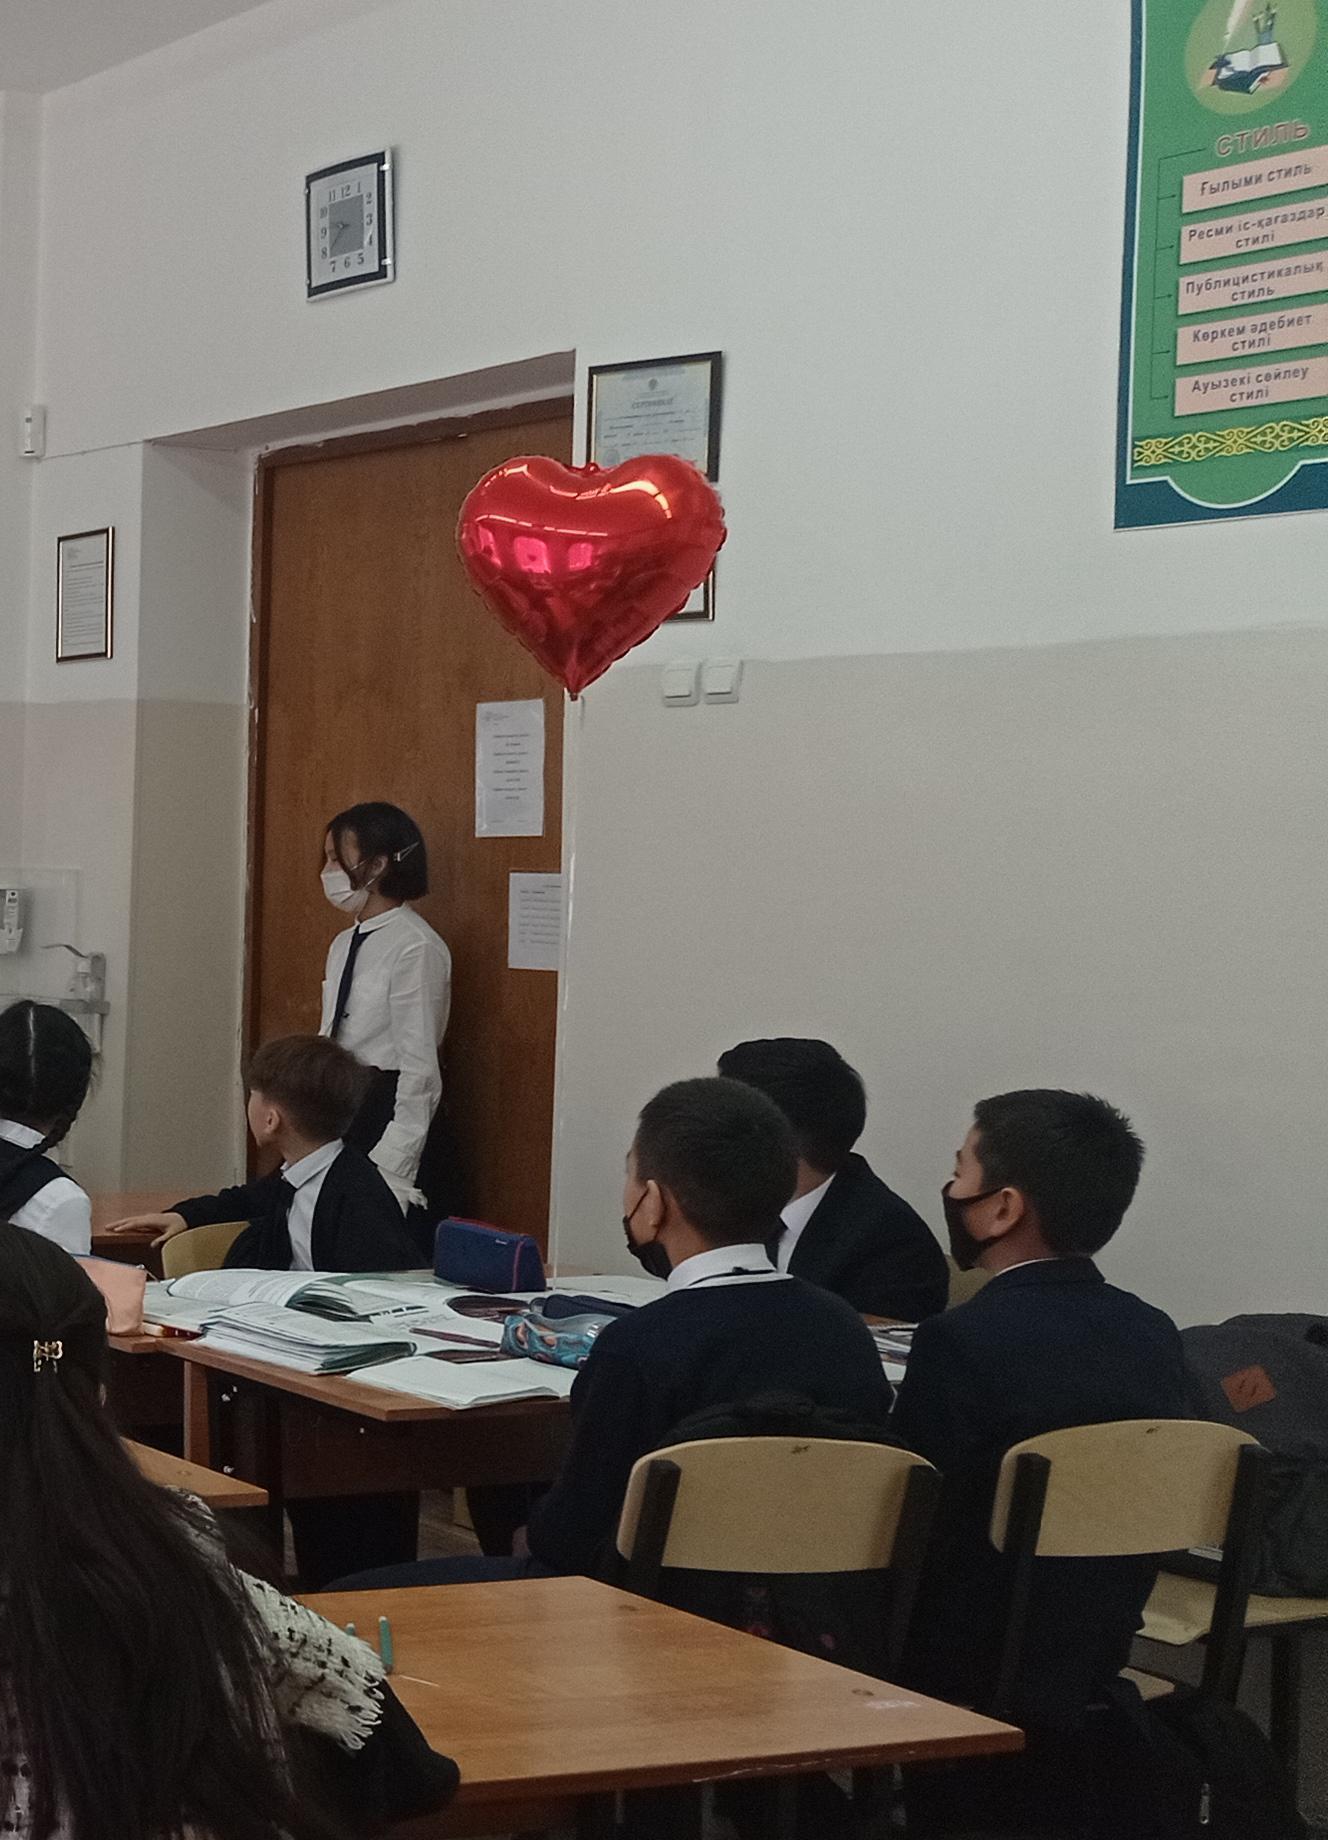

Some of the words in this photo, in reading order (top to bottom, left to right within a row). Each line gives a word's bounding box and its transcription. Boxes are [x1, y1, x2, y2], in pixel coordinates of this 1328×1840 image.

[1216, 119, 1310, 156] СТИЛЬ
[1200, 174, 1263, 197] Ғылыми
[1267, 162, 1312, 182] стиль
[341, 185, 351, 197] 12
[356, 182, 361, 194] 1
[366, 192, 372, 205] 2
[366, 213, 373, 226] 3
[321, 227, 327, 240] 9
[1188, 224, 1234, 242] Ресми
[1236, 233, 1275, 249] стилі
[321, 248, 328, 260] 8
[357, 253, 364, 266] 5
[329, 260, 336, 273] 7
[344, 256, 351, 269] 6
[1185, 259, 1323, 296] Публицистикалық
[1231, 285, 1275, 302] стиль
[1192, 324, 1246, 344] Көркем
[1249, 313, 1313, 337] әдебиет
[1232, 336, 1271, 352] стилі
[1192, 375, 1251, 393] Ауызекі
[1255, 366, 1310, 384] сөйлеу
[1230, 387, 1269, 403] стилі
